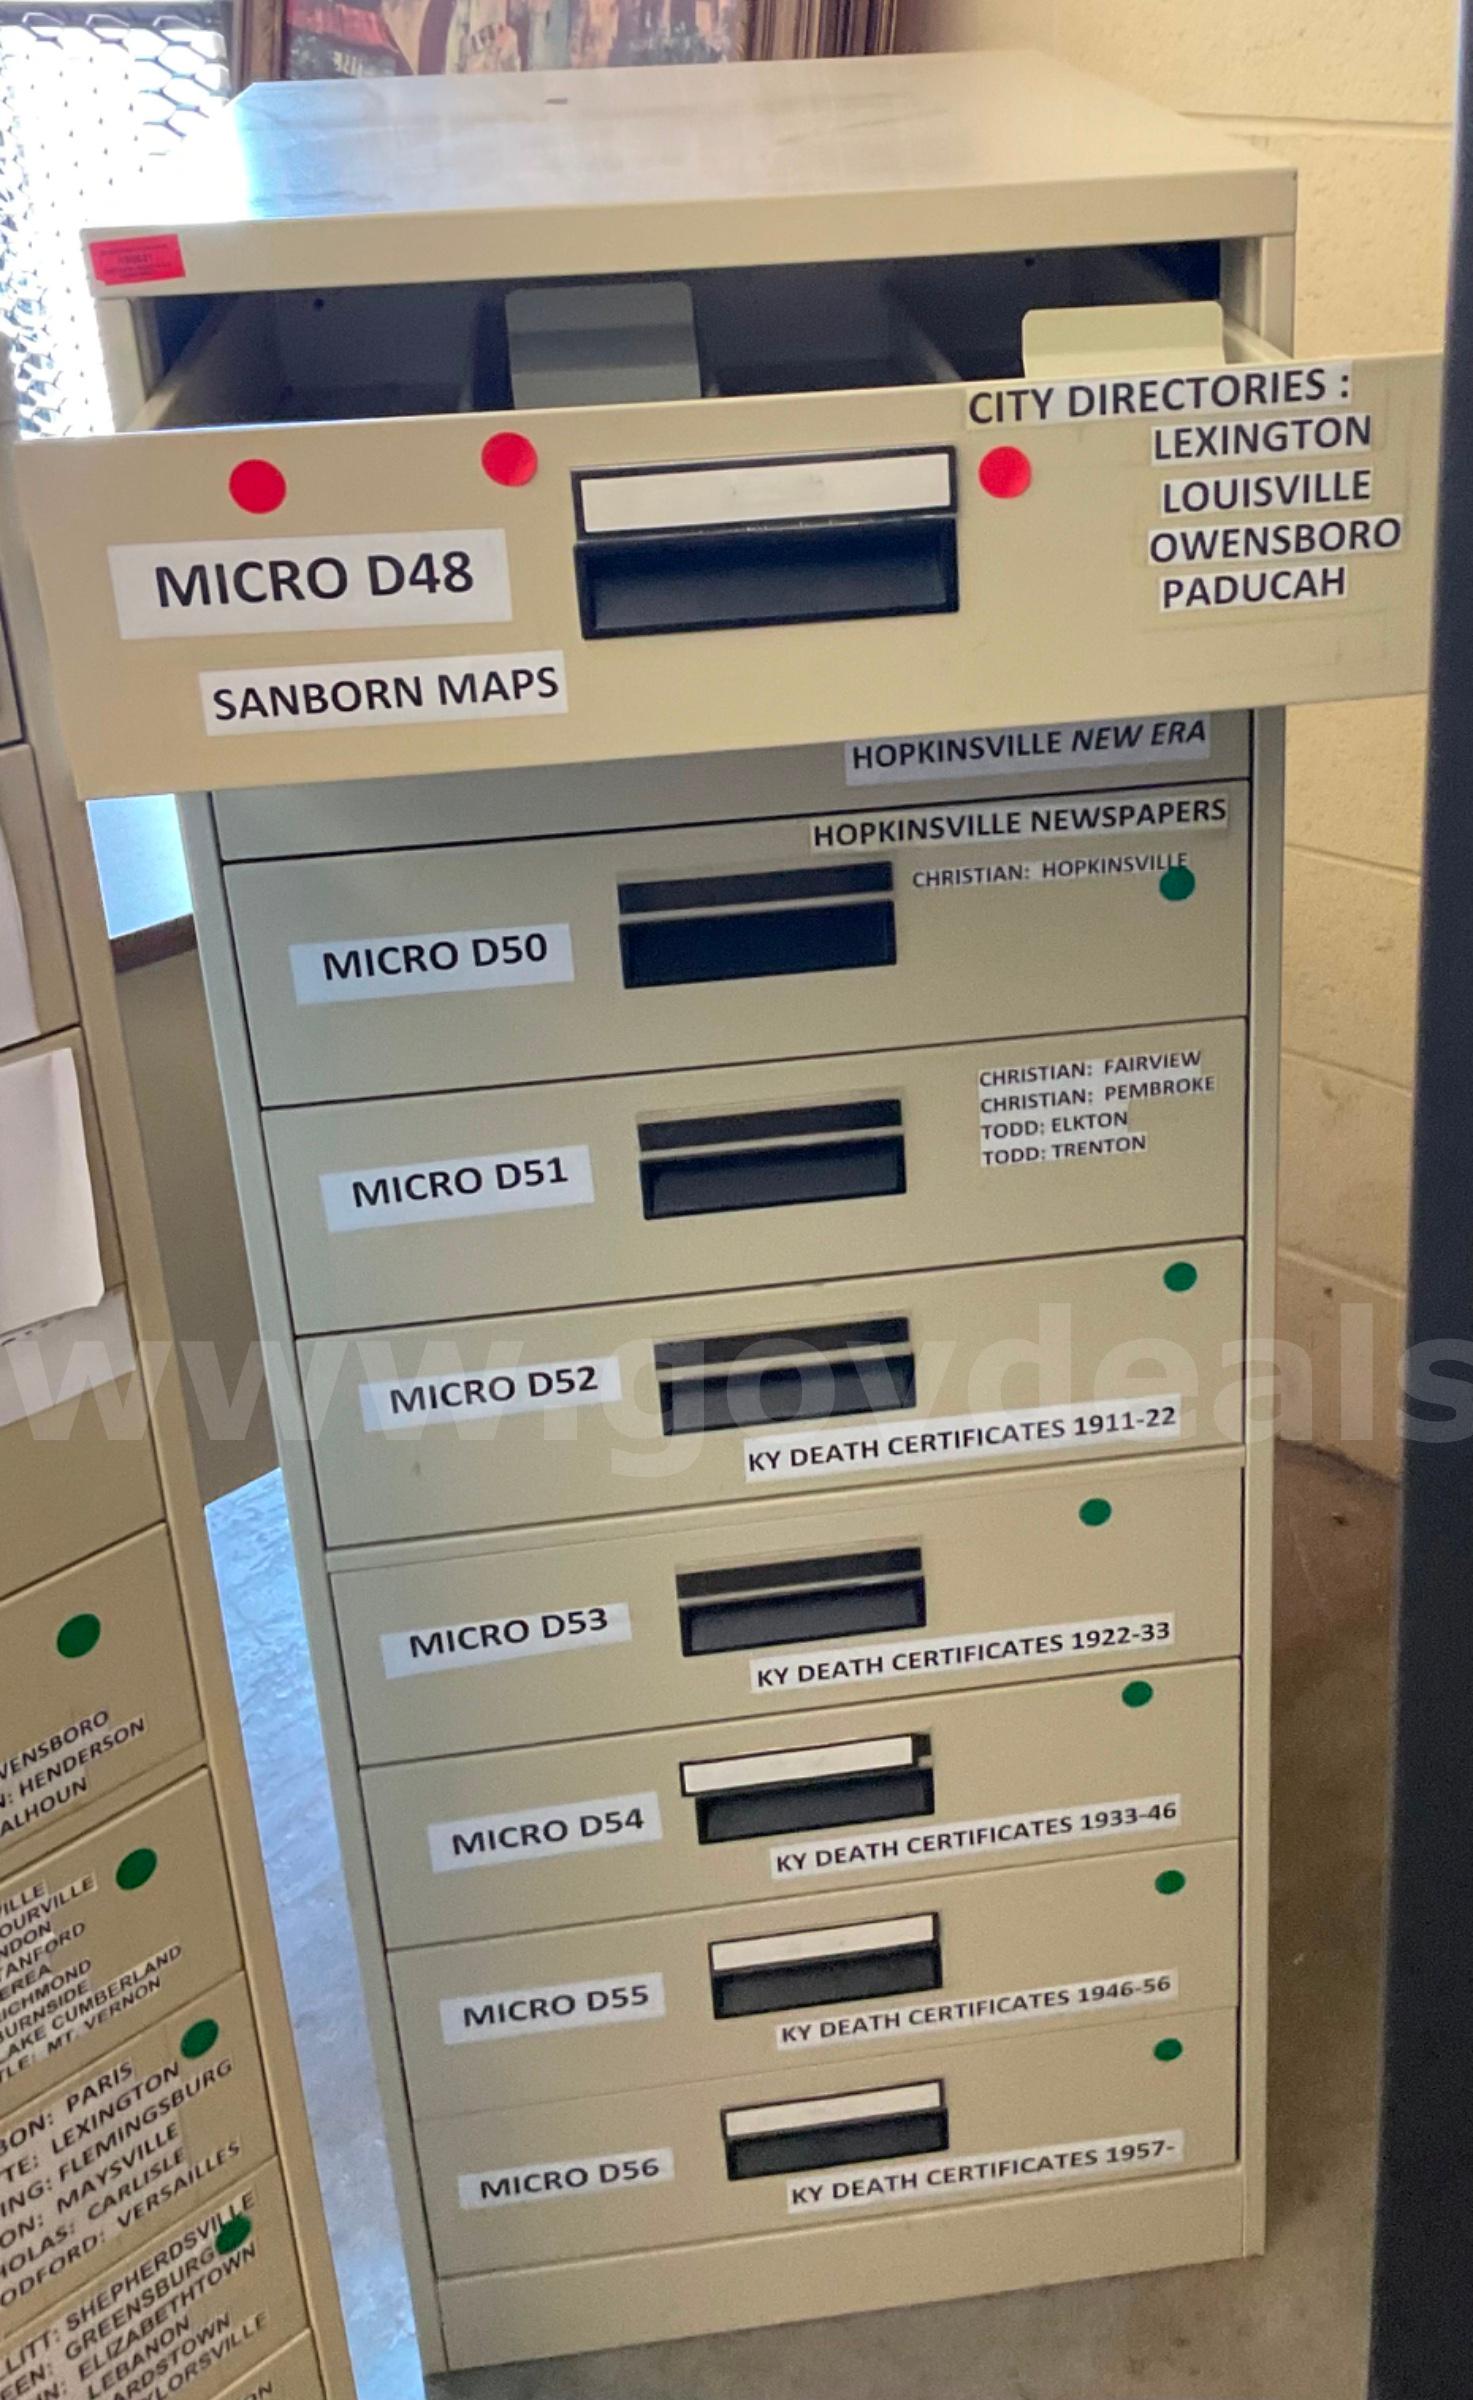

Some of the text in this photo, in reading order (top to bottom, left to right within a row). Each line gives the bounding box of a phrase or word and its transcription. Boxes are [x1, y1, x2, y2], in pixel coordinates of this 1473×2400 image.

[969, 387, 1055, 424] CITY
[1068, 367, 1327, 417] DIRECTORIES
[1153, 415, 1372, 460] LEXINGTON
[1163, 469, 1372, 514] LOUISVILLE
[1149, 517, 1401, 563] OWENSBORO
[154, 550, 475, 608] MICRO D48
[1162, 566, 1346, 609] PADUCAH
[212, 666, 560, 721] SANBORN MAPS
[852, 719, 1206, 769] HOPKINSVILLE NEW ERA
[813, 798, 1227, 847] HOPKINSVILLE NEWSPAPERS
[912, 852, 1189, 889] CHRISTIAN: HOPKINSVILLE
[321, 933, 548, 981] MICRO D50
[979, 1051, 1202, 1088] CHRISTIAN: FAIRVIEW
[980, 1076, 1215, 1114] CHRISTIAN: PEMBROKE
[981, 1111, 1128, 1140] TODD: ELKTON
[982, 1135, 1147, 1166] TODD: TRENTON
[351, 1156, 569, 1208] MICRO D51
[389, 1365, 600, 1415] MICRO D52
[747, 1405, 1178, 1473] KY DEATH CERTIFICATES 1911-22
[408, 1607, 610, 1659] MICRO D53
[756, 1620, 1172, 1689] KY DEATH CERTIFICATES 1922-33
[19, 1717, 145, 1797] HENDERSON
[452, 1808, 645, 1856] MICRO D54
[776, 1801, 1178, 1873] KY DEATH CERTIFICATES 1933-46
[0, 1884, 45, 1916] ILLE
[0, 1922, 86, 1981] ANFORD
[0, 1960, 92, 2021] ICHMOND
[51, 1945, 183, 2030] CUMBERLAND
[84, 1976, 162, 2031] VERNON
[463, 1984, 650, 2028] MICRO D55
[781, 1975, 1172, 2044] KY DEATH CERTIFICATES 1946-56
[66, 2061, 134, 2114] PARIS
[0, 2061, 180, 2182] TE: LEXINGTON
[58, 2058, 233, 2183] FLEMINGSBURG
[56, 2121, 179, 2215] MAYSVILLE
[87, 2146, 187, 2221] CARLISLE
[478, 2156, 662, 2201] MICRO D56
[790, 2138, 1177, 2206] KY DEATH CERTIFICATES 1957-
[0, 2140, 241, 2308] ODFORD: VERSAILLES
[0, 2189, 256, 2382] LITT: SHEPHERDSVILLE
[64, 2246, 216, 2362] GREENSBURG
[77, 2242, 256, 2382] ELIZABETHTOWN
[87, 2313, 190, 2400] LEBANON
